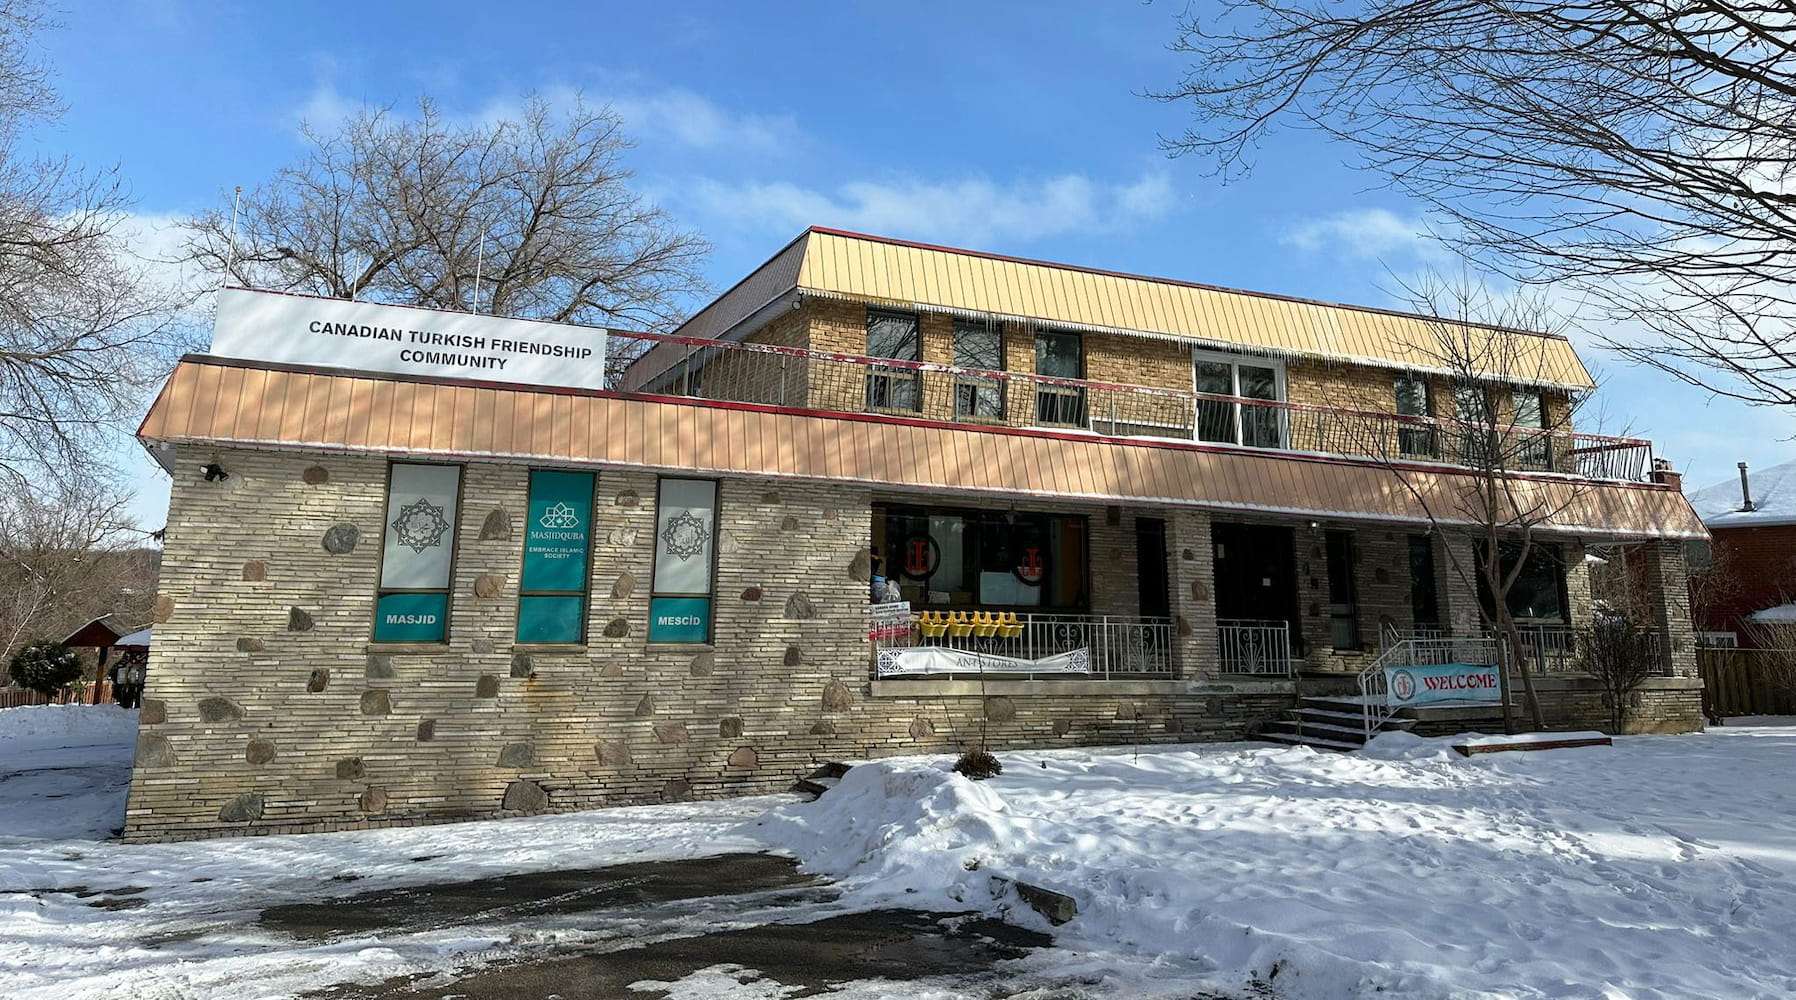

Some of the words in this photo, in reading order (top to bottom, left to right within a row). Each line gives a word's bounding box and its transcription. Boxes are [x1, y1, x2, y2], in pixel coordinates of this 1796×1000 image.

[309, 320, 402, 342] CANADIAN
[408, 330, 486, 349] TURKISH
[491, 338, 592, 360] FRIENDSHIP
[400, 349, 508, 370] COMMUNITY
[530, 531, 584, 541] MASJIDQUBA
[386, 614, 436, 624] MASJID
[658, 615, 701, 626] MESCİD
[1423, 674, 1497, 690] WELCOME
